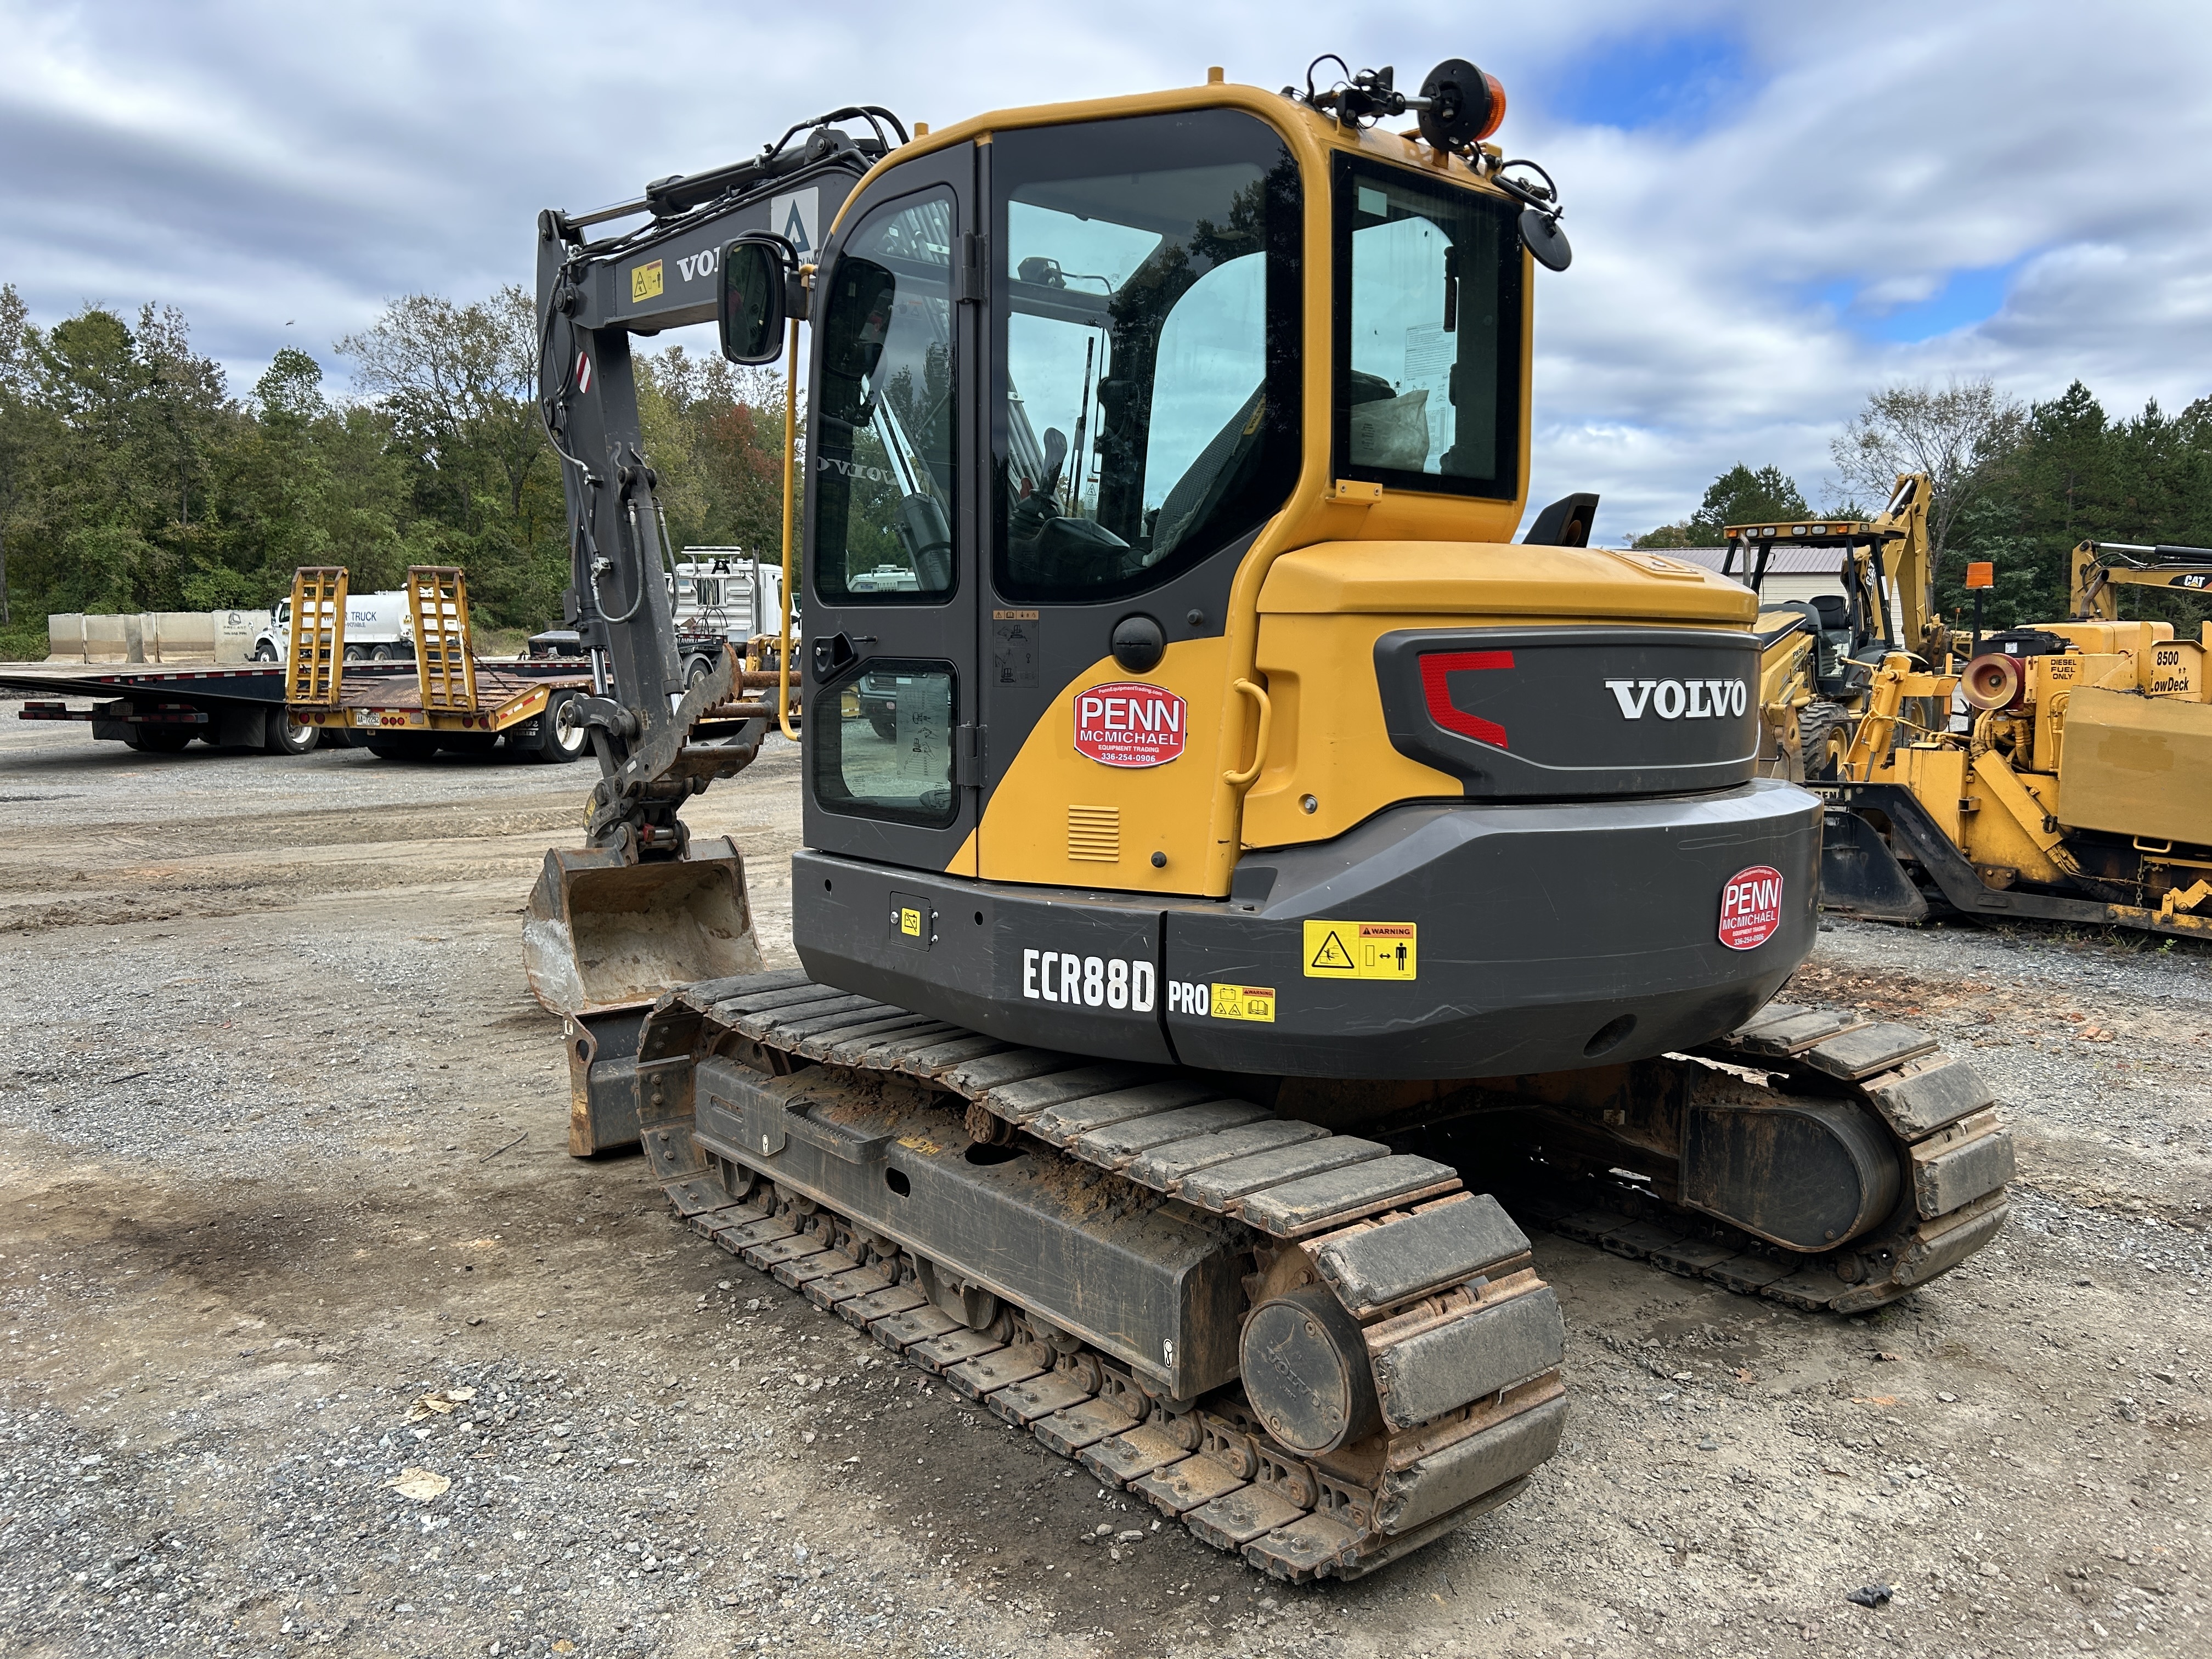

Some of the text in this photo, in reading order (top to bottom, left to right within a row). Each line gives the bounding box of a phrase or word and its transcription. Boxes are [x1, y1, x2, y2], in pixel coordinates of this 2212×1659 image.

[2184, 575, 2205, 588] CAT
[351, 611, 377, 622] TRUCK
[2157, 651, 2179, 666] 8500
[1098, 686, 1163, 697] PennEquipmentTrading.com
[1605, 679, 1747, 719] VOLVO
[1081, 697, 1180, 732] PENN
[1080, 730, 1179, 746] MCMICHAEL
[1098, 744, 1160, 753] EQUIPMENT TRADING
[1101, 752, 1156, 763] 336-254-0906
[1724, 877, 1780, 918] PENN
[1722, 910, 1776, 930] MCMICHAEL
[1023, 948, 1209, 1016] ECR88D PRO
